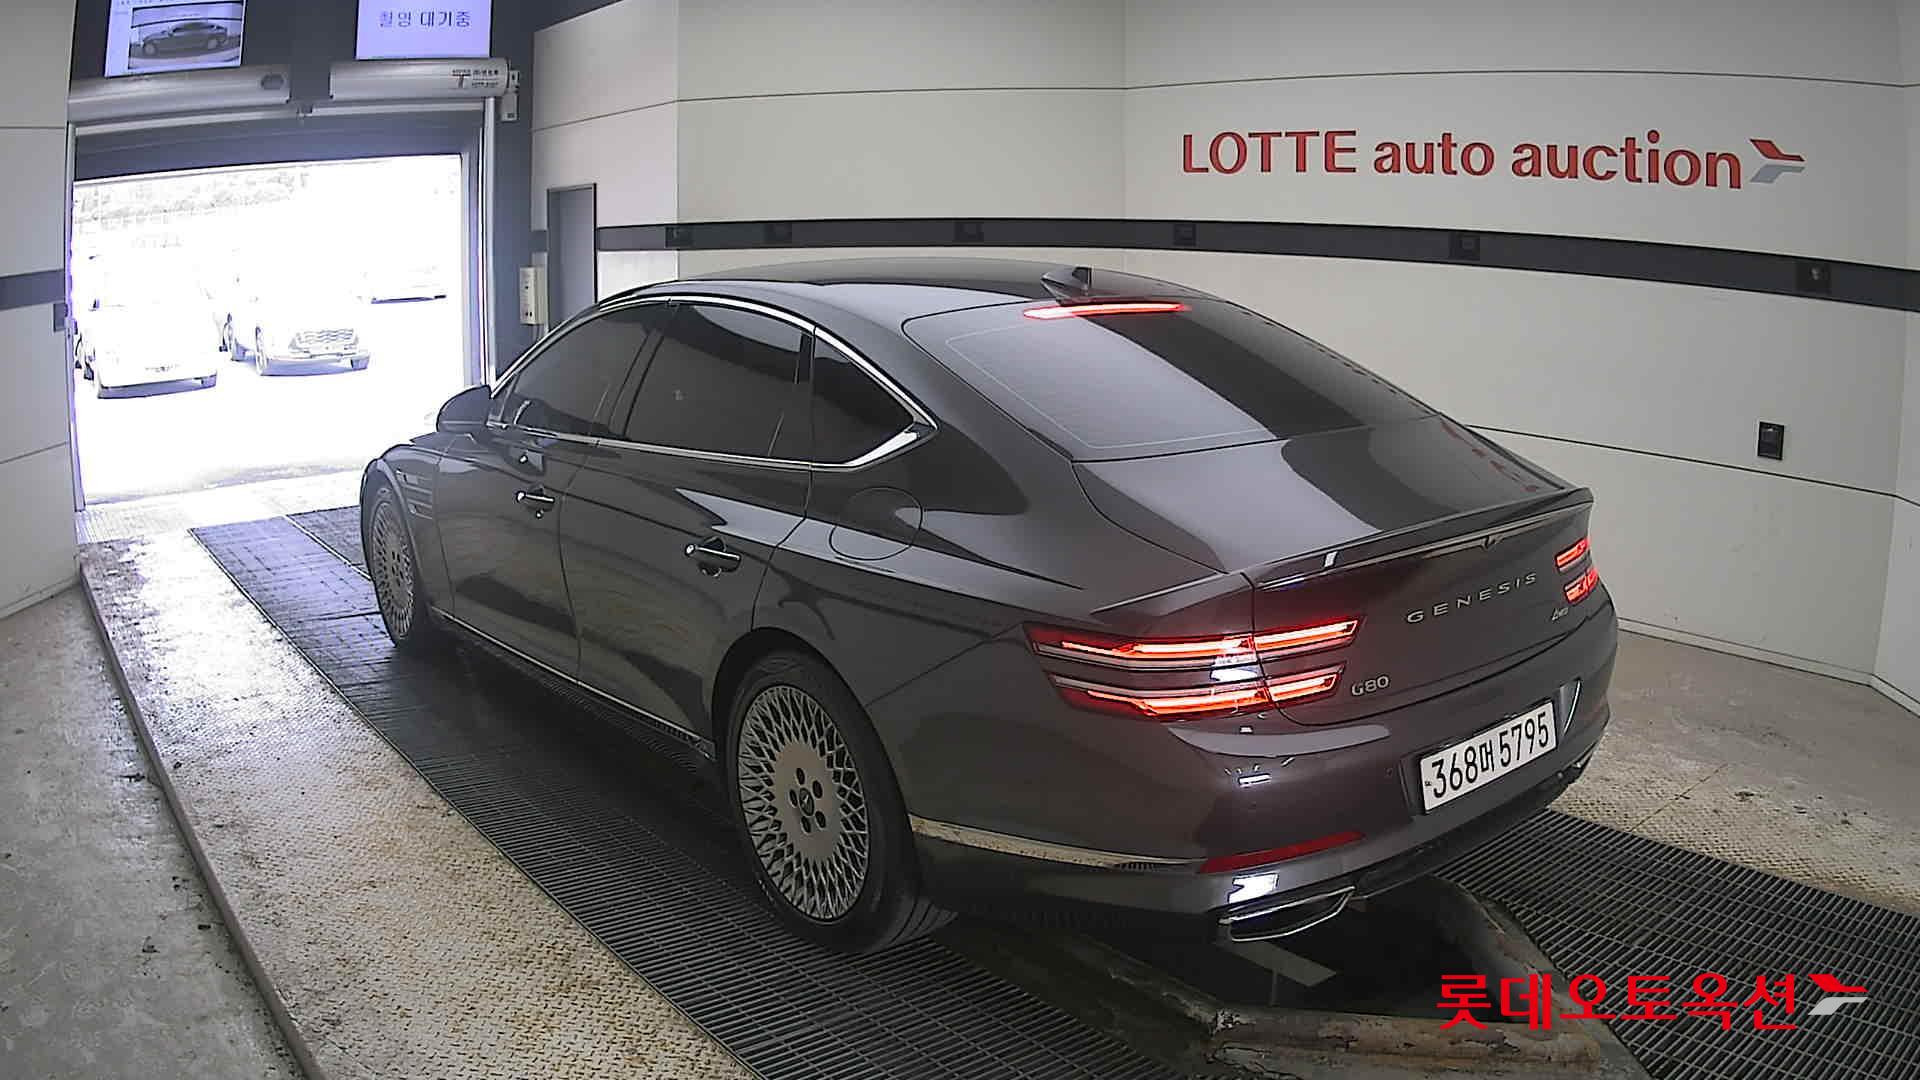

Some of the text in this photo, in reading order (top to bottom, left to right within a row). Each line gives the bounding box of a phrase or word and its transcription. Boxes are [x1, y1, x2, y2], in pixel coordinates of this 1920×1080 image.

[420, 10, 472, 28] 대기중
[1184, 131, 1741, 189] LOTTE auto auction
[1407, 573, 1536, 623] GENESIS
[1351, 675, 1391, 696] G80
